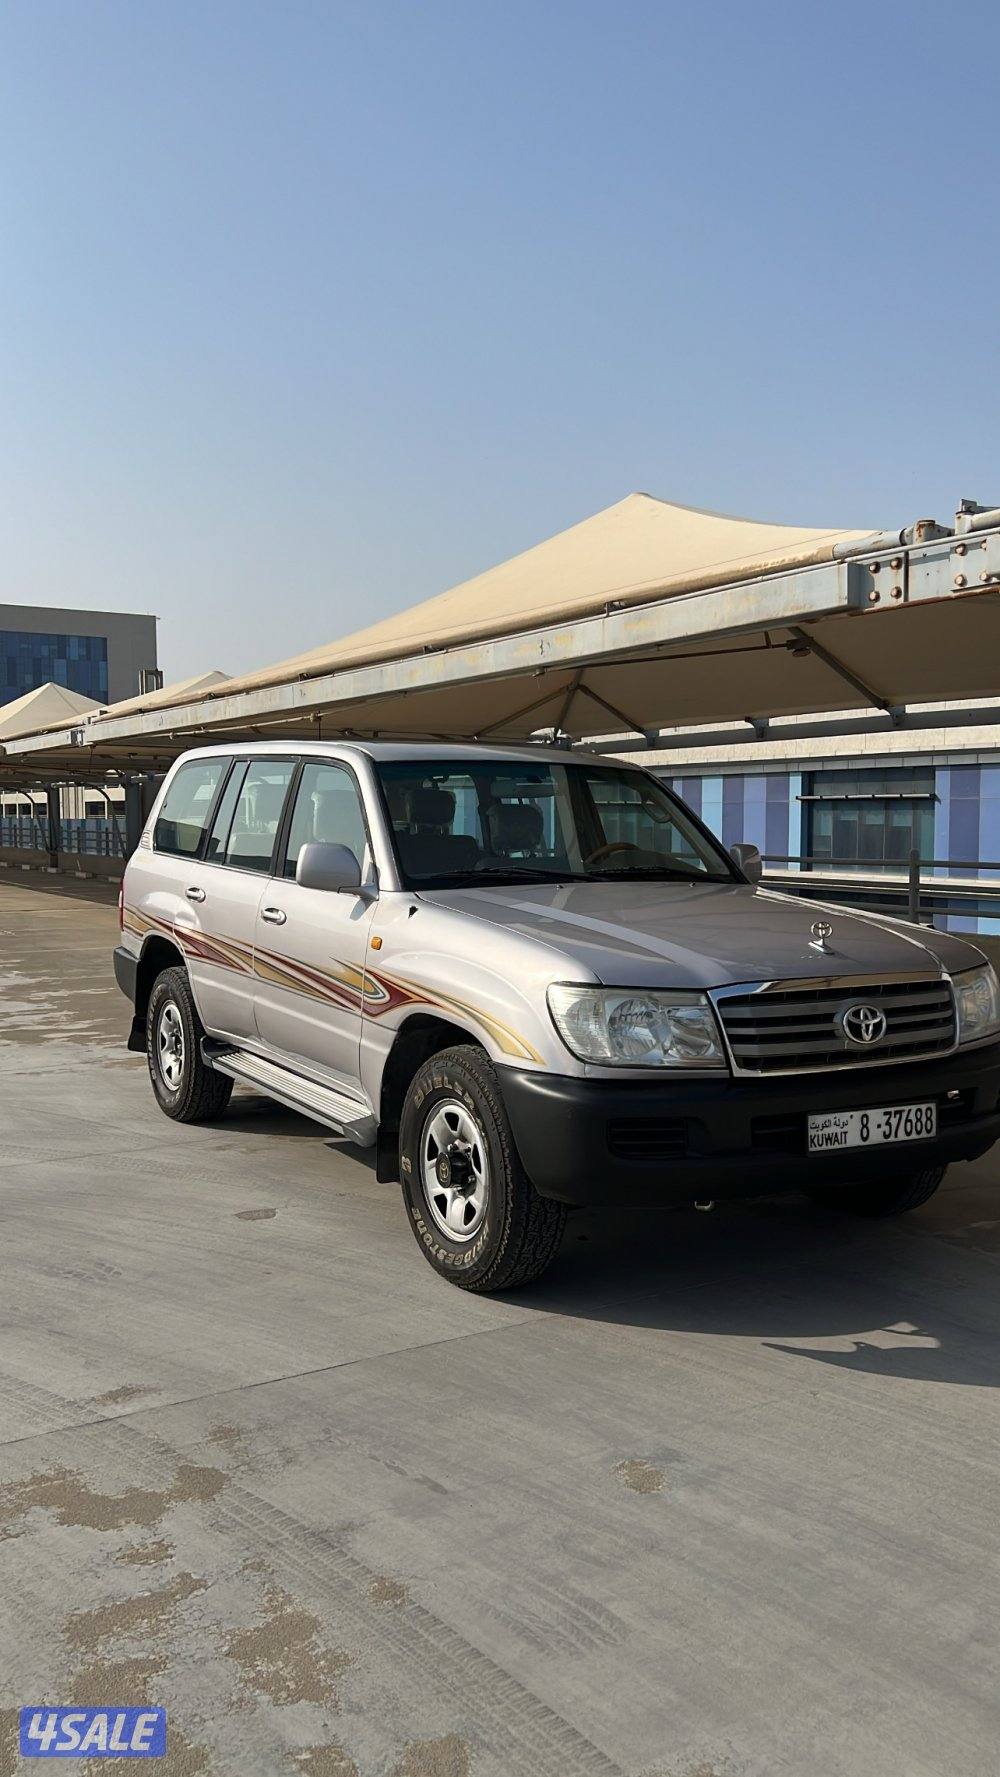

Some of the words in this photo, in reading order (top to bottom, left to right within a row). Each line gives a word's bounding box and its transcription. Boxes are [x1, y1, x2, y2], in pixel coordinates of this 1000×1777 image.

[810, 1119, 831, 1132] الكويت
[833, 1116, 849, 1129] دولة
[810, 1131, 848, 1148] KUWAIT
